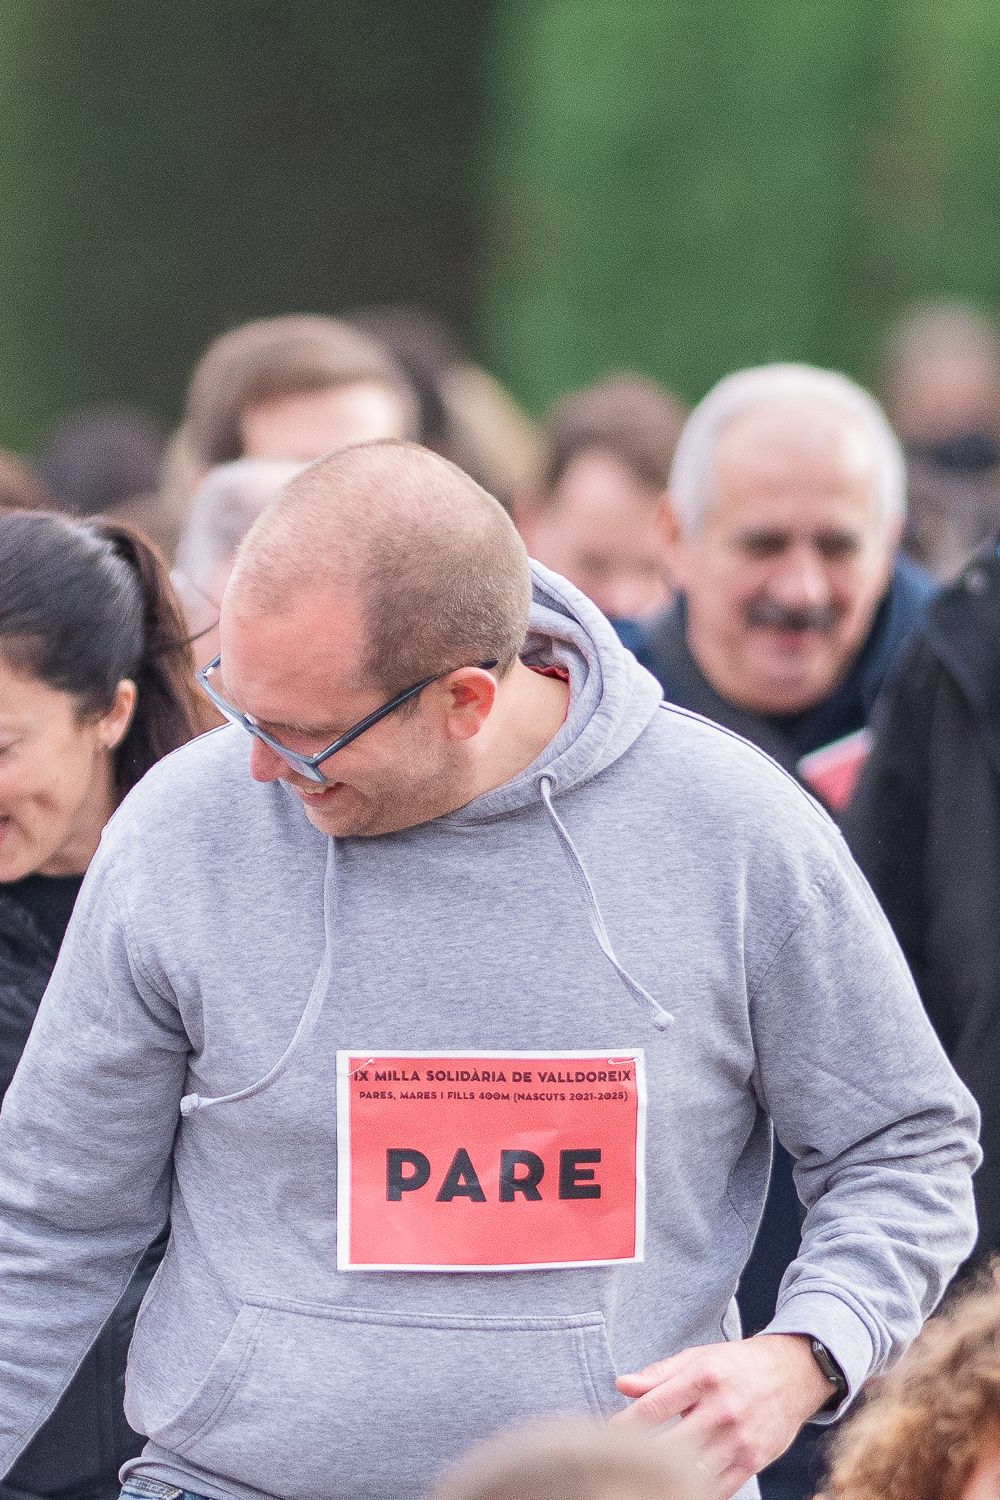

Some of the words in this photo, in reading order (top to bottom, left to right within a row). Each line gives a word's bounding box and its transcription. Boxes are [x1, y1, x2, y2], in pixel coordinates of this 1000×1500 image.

[353, 1070, 369, 1081] IX
[374, 1070, 420, 1081] MILLA
[426, 1067, 506, 1082] SOLIDÀRIA
[512, 1072, 532, 1082] DE
[537, 1070, 631, 1083] VALLDOREIX
[359, 1091, 396, 1100] PARES,
[400, 1091, 437, 1100] MARES
[447, 1092, 475, 1100] FILLS
[478, 1092, 510, 1101] 400M
[513, 1092, 566, 1103] (NASCUTS
[569, 1091, 628, 1102] 2021-2025)
[385, 1147, 602, 1203] PARE
